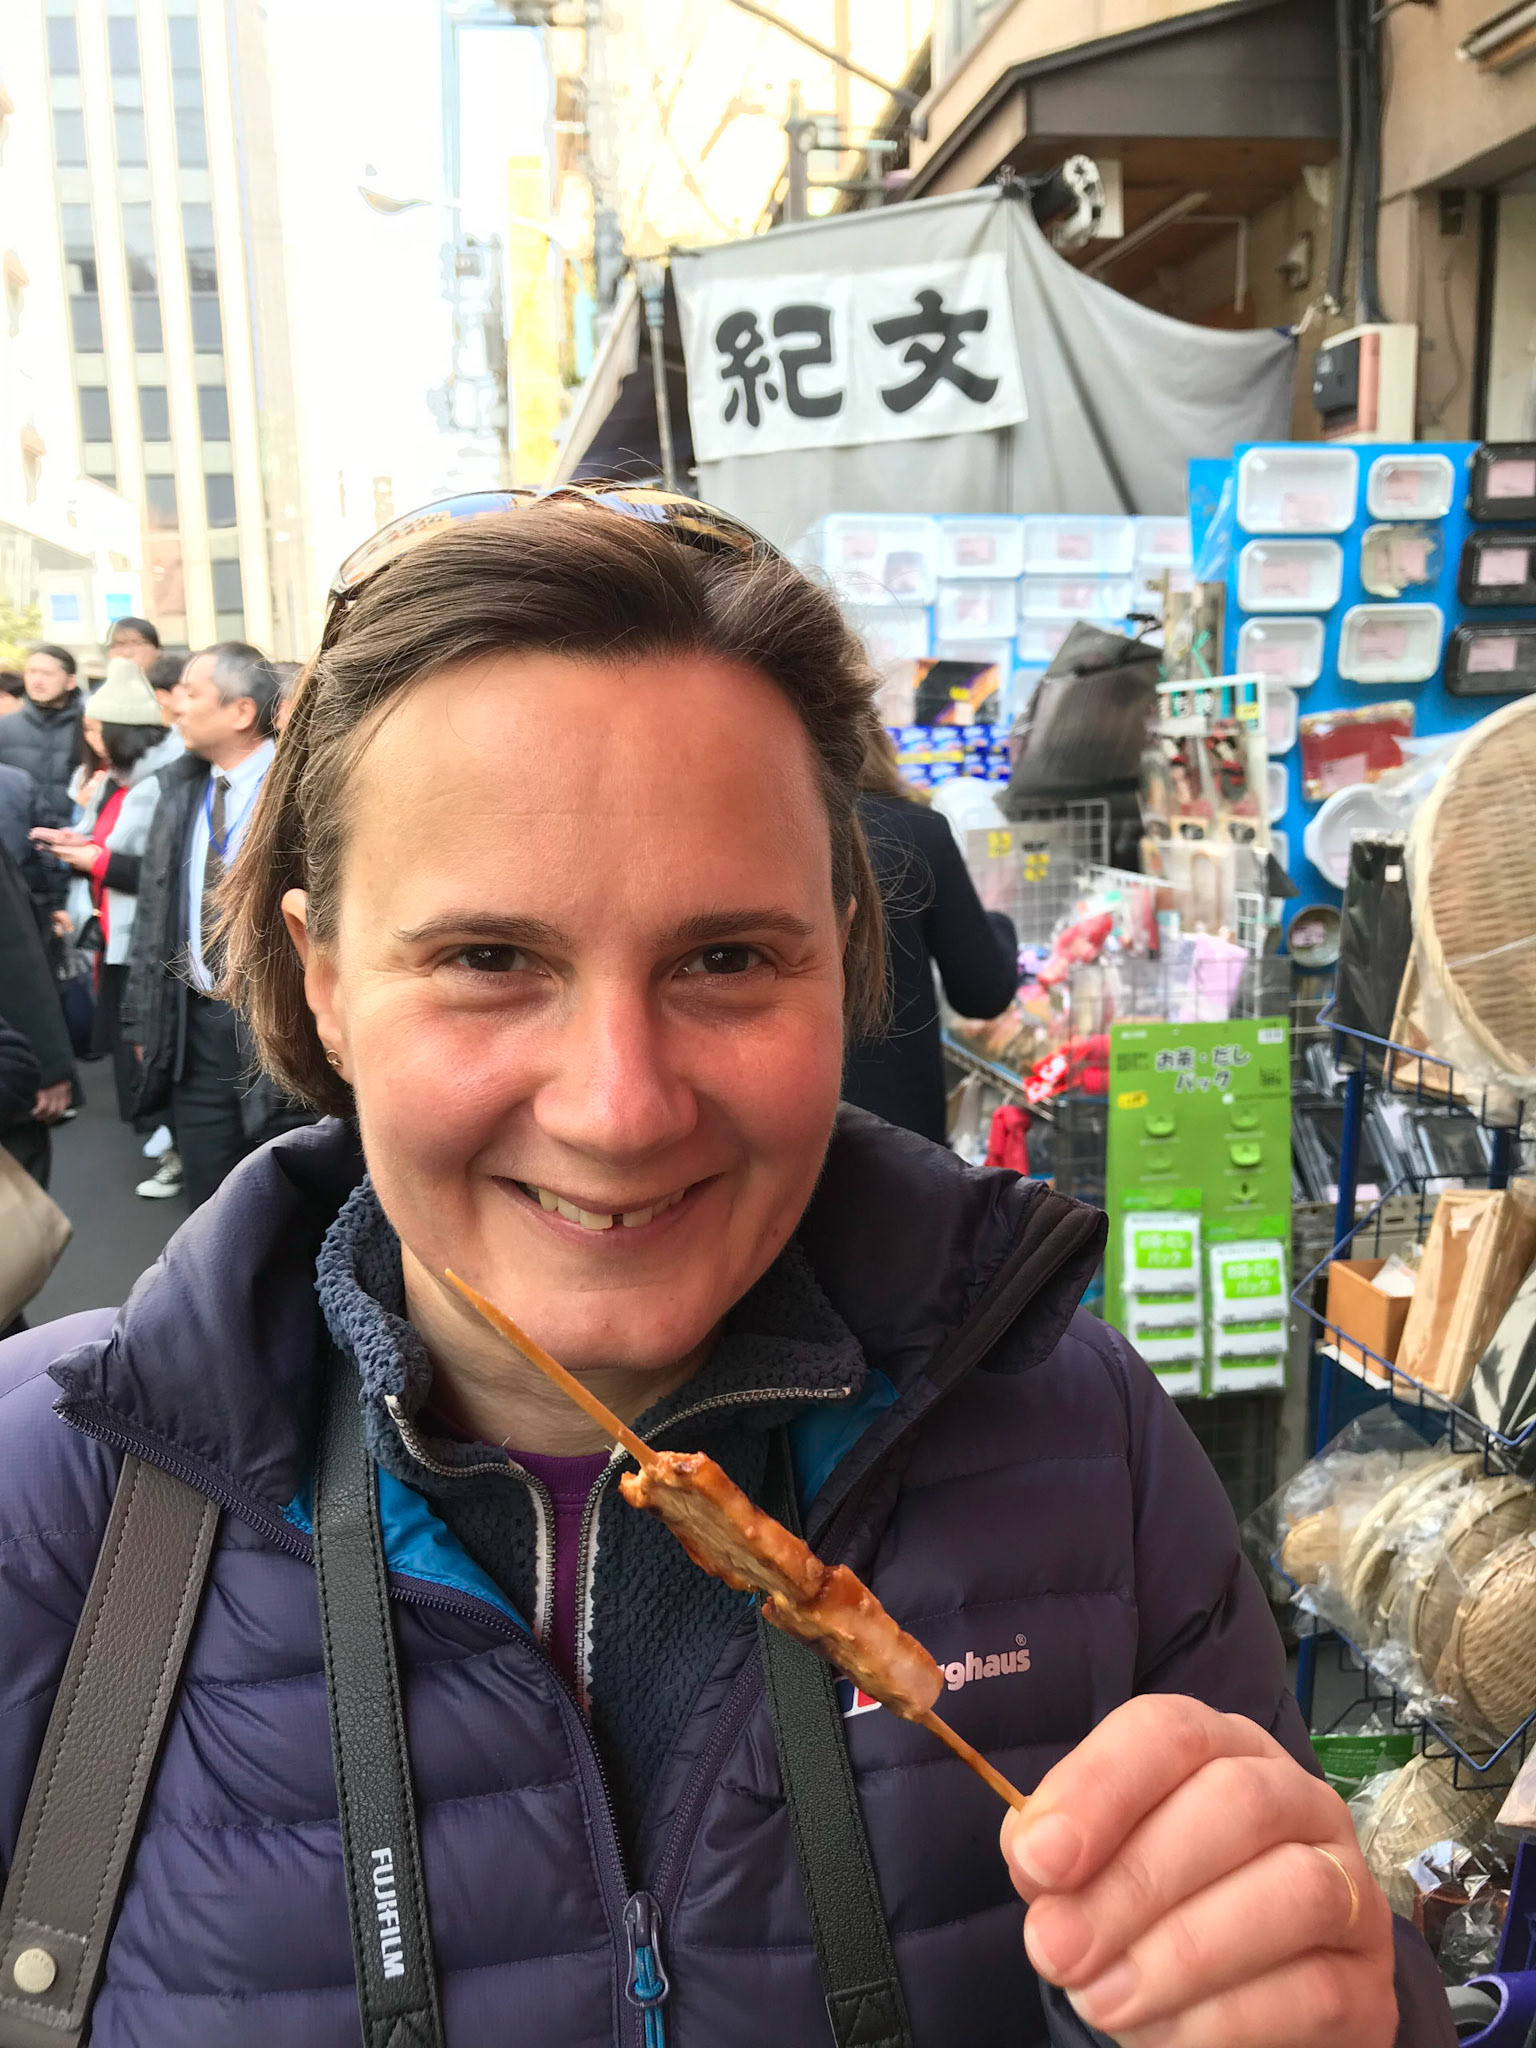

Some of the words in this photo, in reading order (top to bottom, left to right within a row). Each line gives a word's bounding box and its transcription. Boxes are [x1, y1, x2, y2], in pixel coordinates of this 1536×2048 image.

[715, 288, 1000, 428] 紀文
[1175, 1071, 1232, 1093] パック
[936, 1649, 1031, 1691] ghaus
[371, 1847, 405, 1980] FUJIFILM
